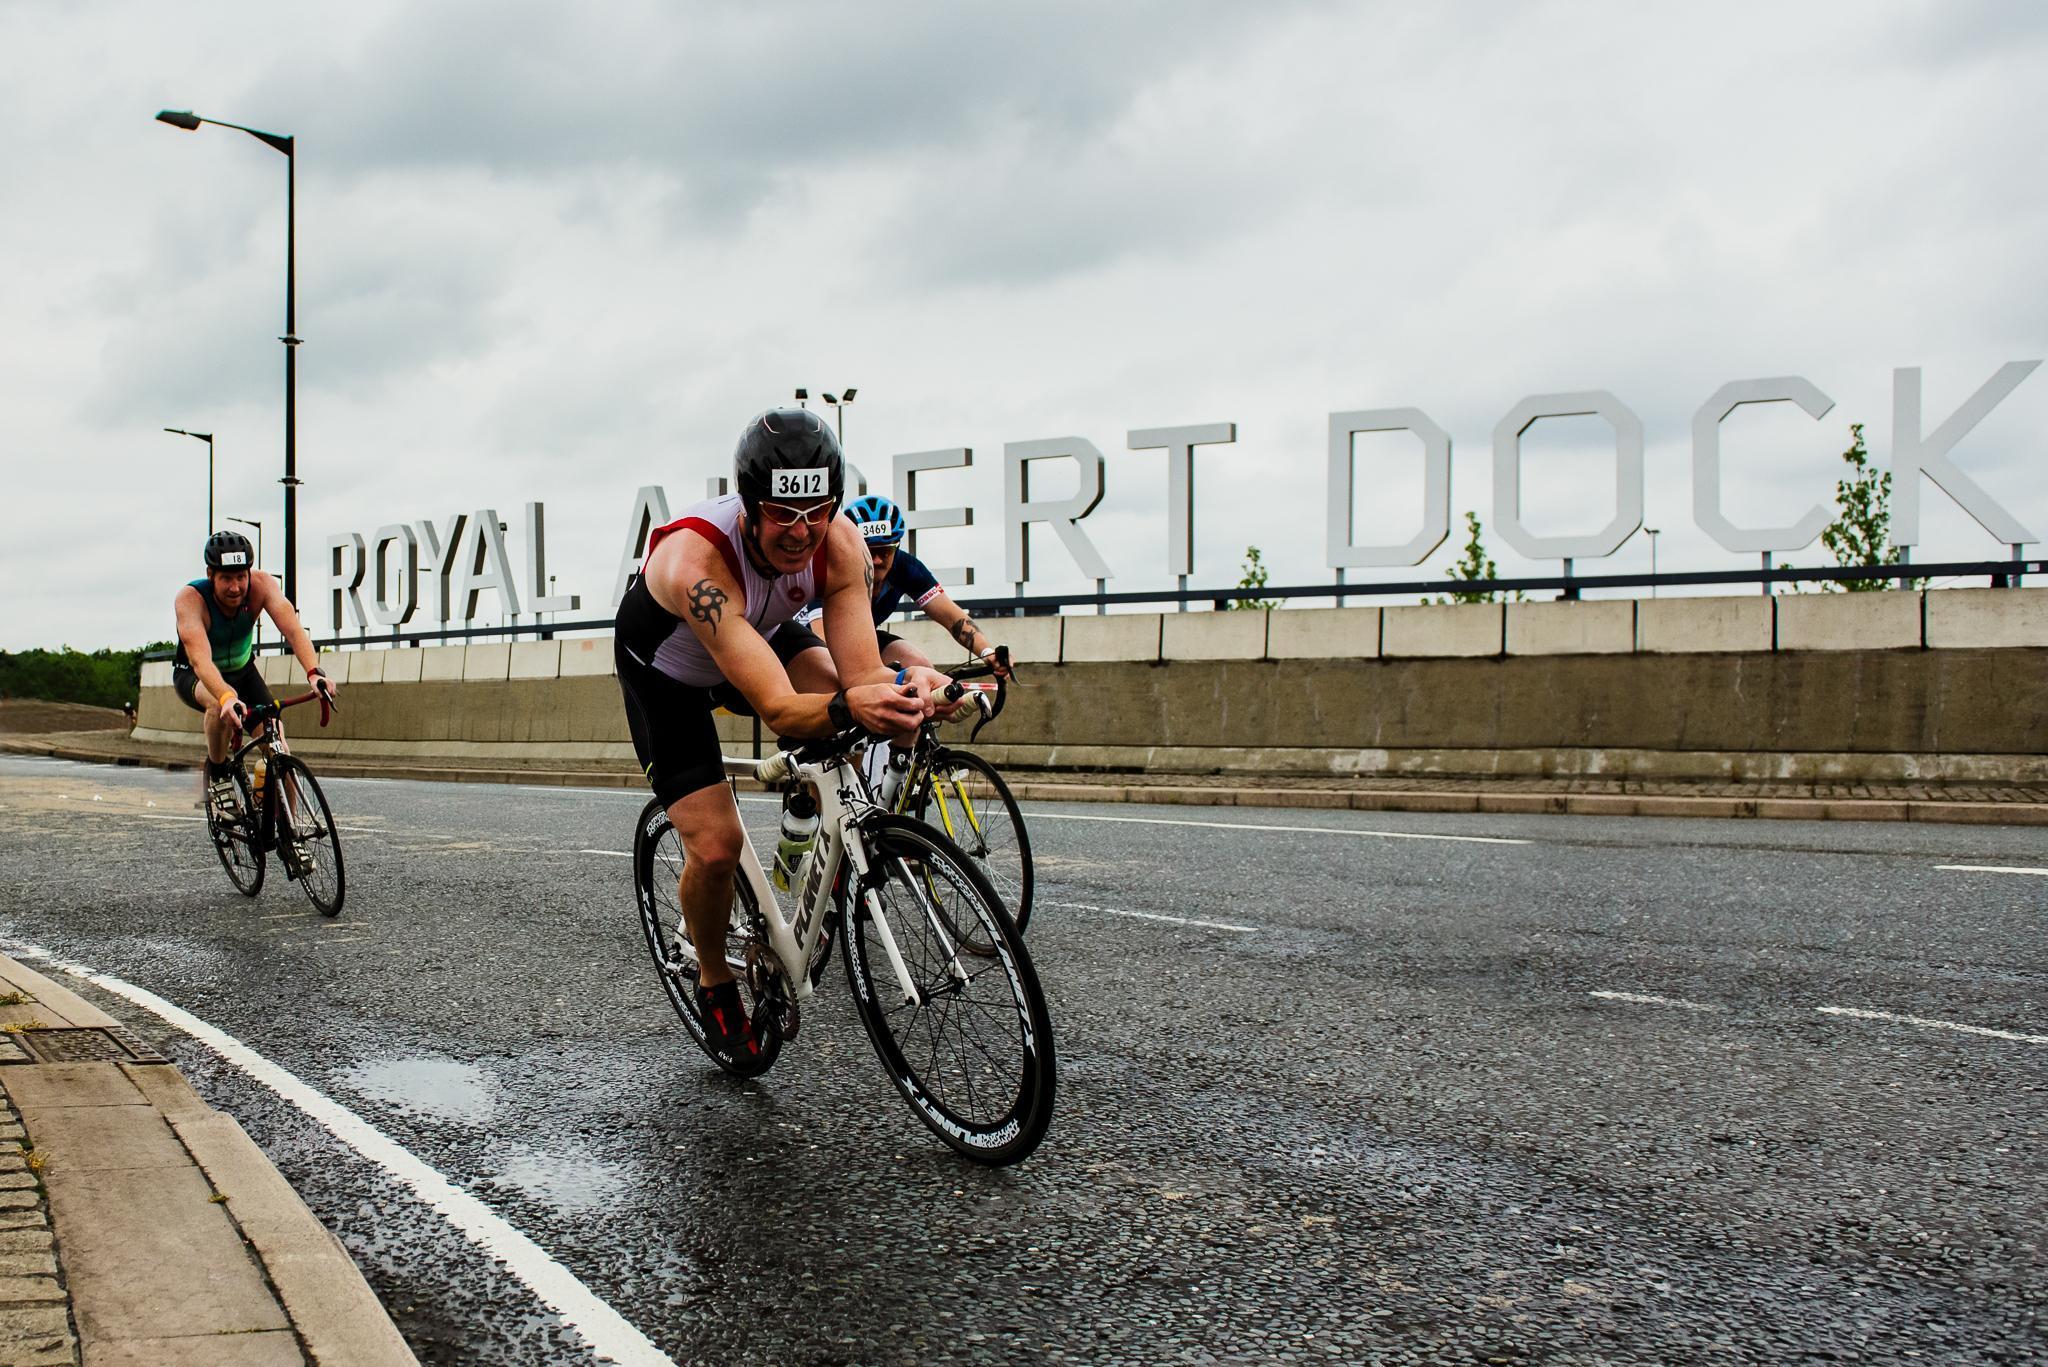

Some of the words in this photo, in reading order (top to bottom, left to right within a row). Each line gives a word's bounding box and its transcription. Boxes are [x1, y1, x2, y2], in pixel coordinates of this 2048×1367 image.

[327, 502, 580, 630] ROYAL
[612, 422, 1236, 607] AERT
[1326, 359, 2044, 568] DOCK
[779, 475, 821, 494] 3612
[863, 524, 887, 536] 3469
[232, 554, 242, 564] 18
[794, 843, 826, 951] PLANET
[817, 826, 832, 856] X
[978, 907, 1032, 1031] PLANET
[1022, 1025, 1036, 1058] X
[901, 1075, 919, 1095] X
[914, 1096, 981, 1147] PLANET
